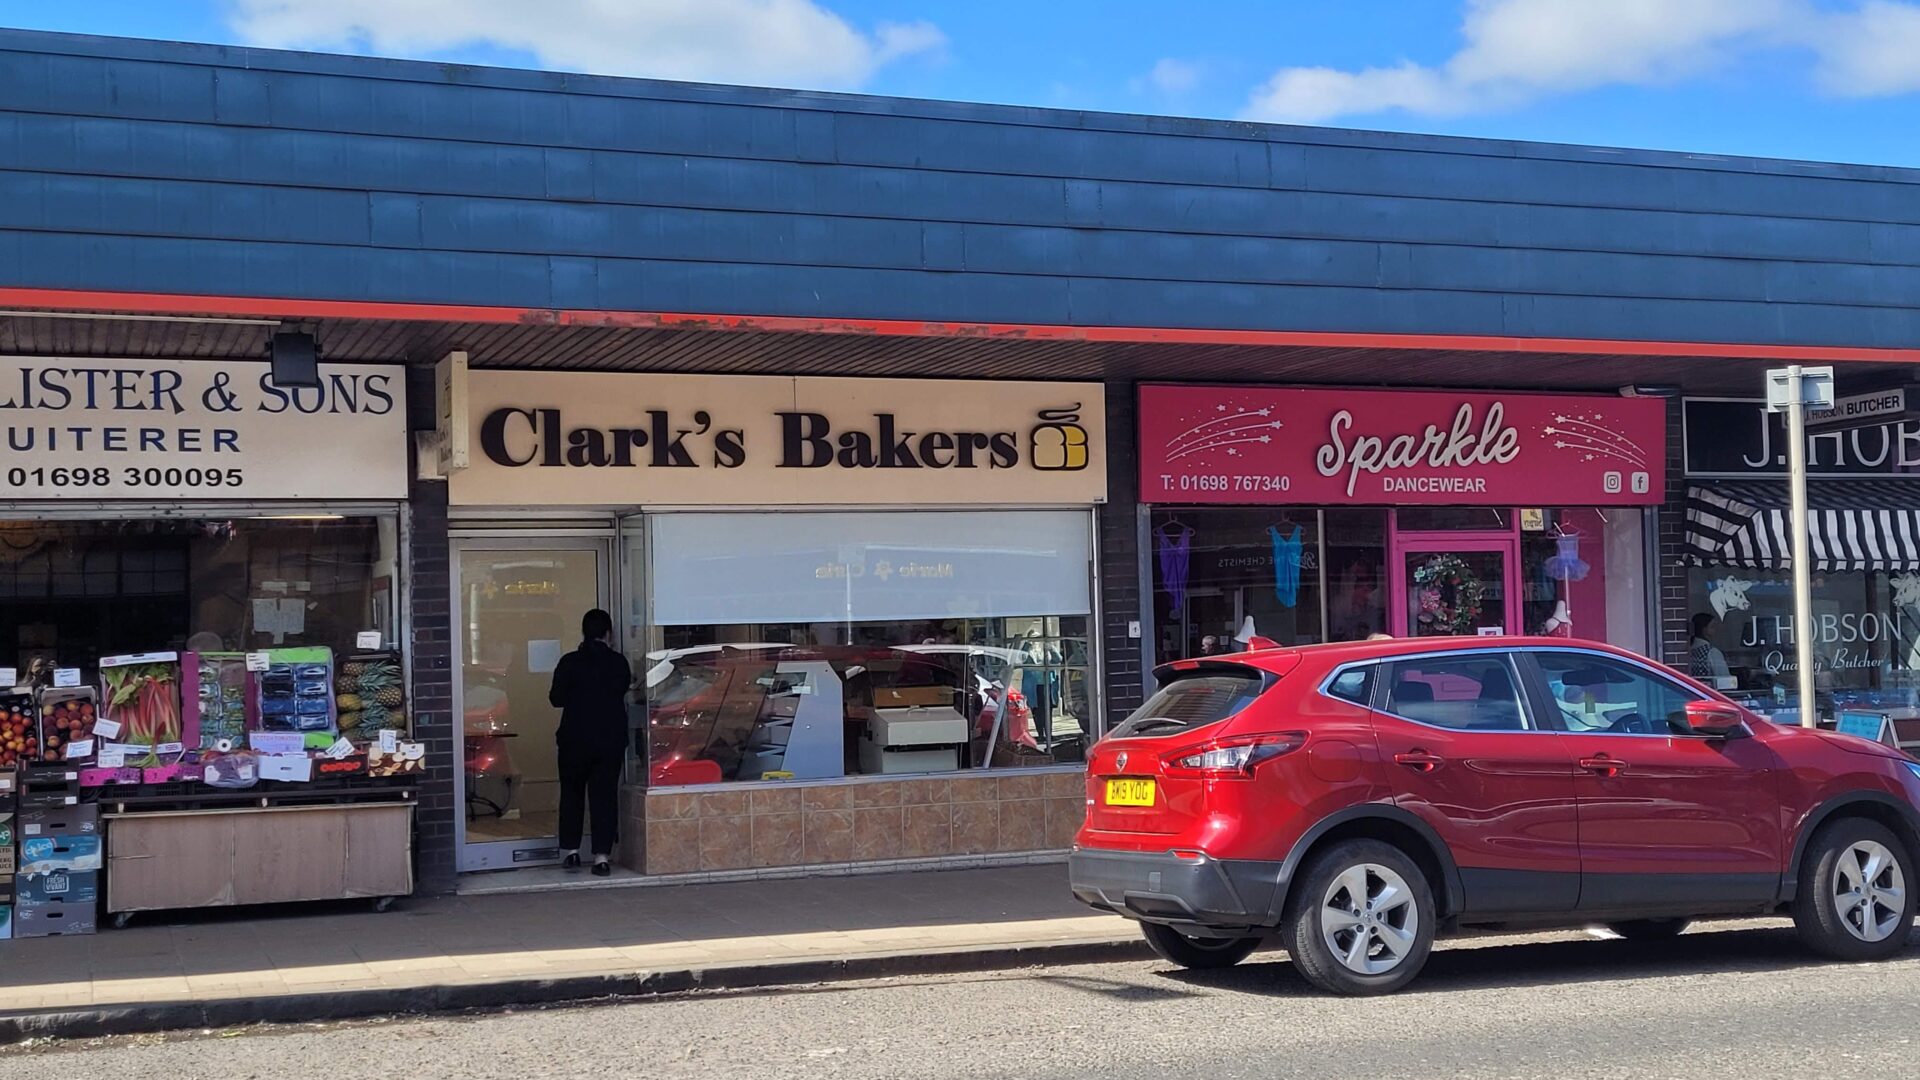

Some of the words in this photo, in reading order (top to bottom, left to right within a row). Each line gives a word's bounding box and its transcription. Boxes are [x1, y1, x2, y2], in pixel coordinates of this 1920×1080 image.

[202, 371, 243, 412] &
[258, 374, 394, 414] SONS
[1846, 395, 1900, 416] BUTCHER
[8, 427, 241, 453] UITERER
[480, 406, 746, 469] Clark's
[774, 411, 1019, 469] Bakers
[1317, 402, 1520, 496] Sparkle
[8, 467, 111, 487] 01698
[123, 468, 244, 487] 300095
[1161, 475, 1175, 490] T:
[1180, 474, 1228, 491] 01698
[1234, 475, 1290, 492] 767340
[1383, 477, 1486, 493] DANCEWEAR
[1765, 650, 1822, 675] Quay
[1831, 647, 1883, 669] Butcher
